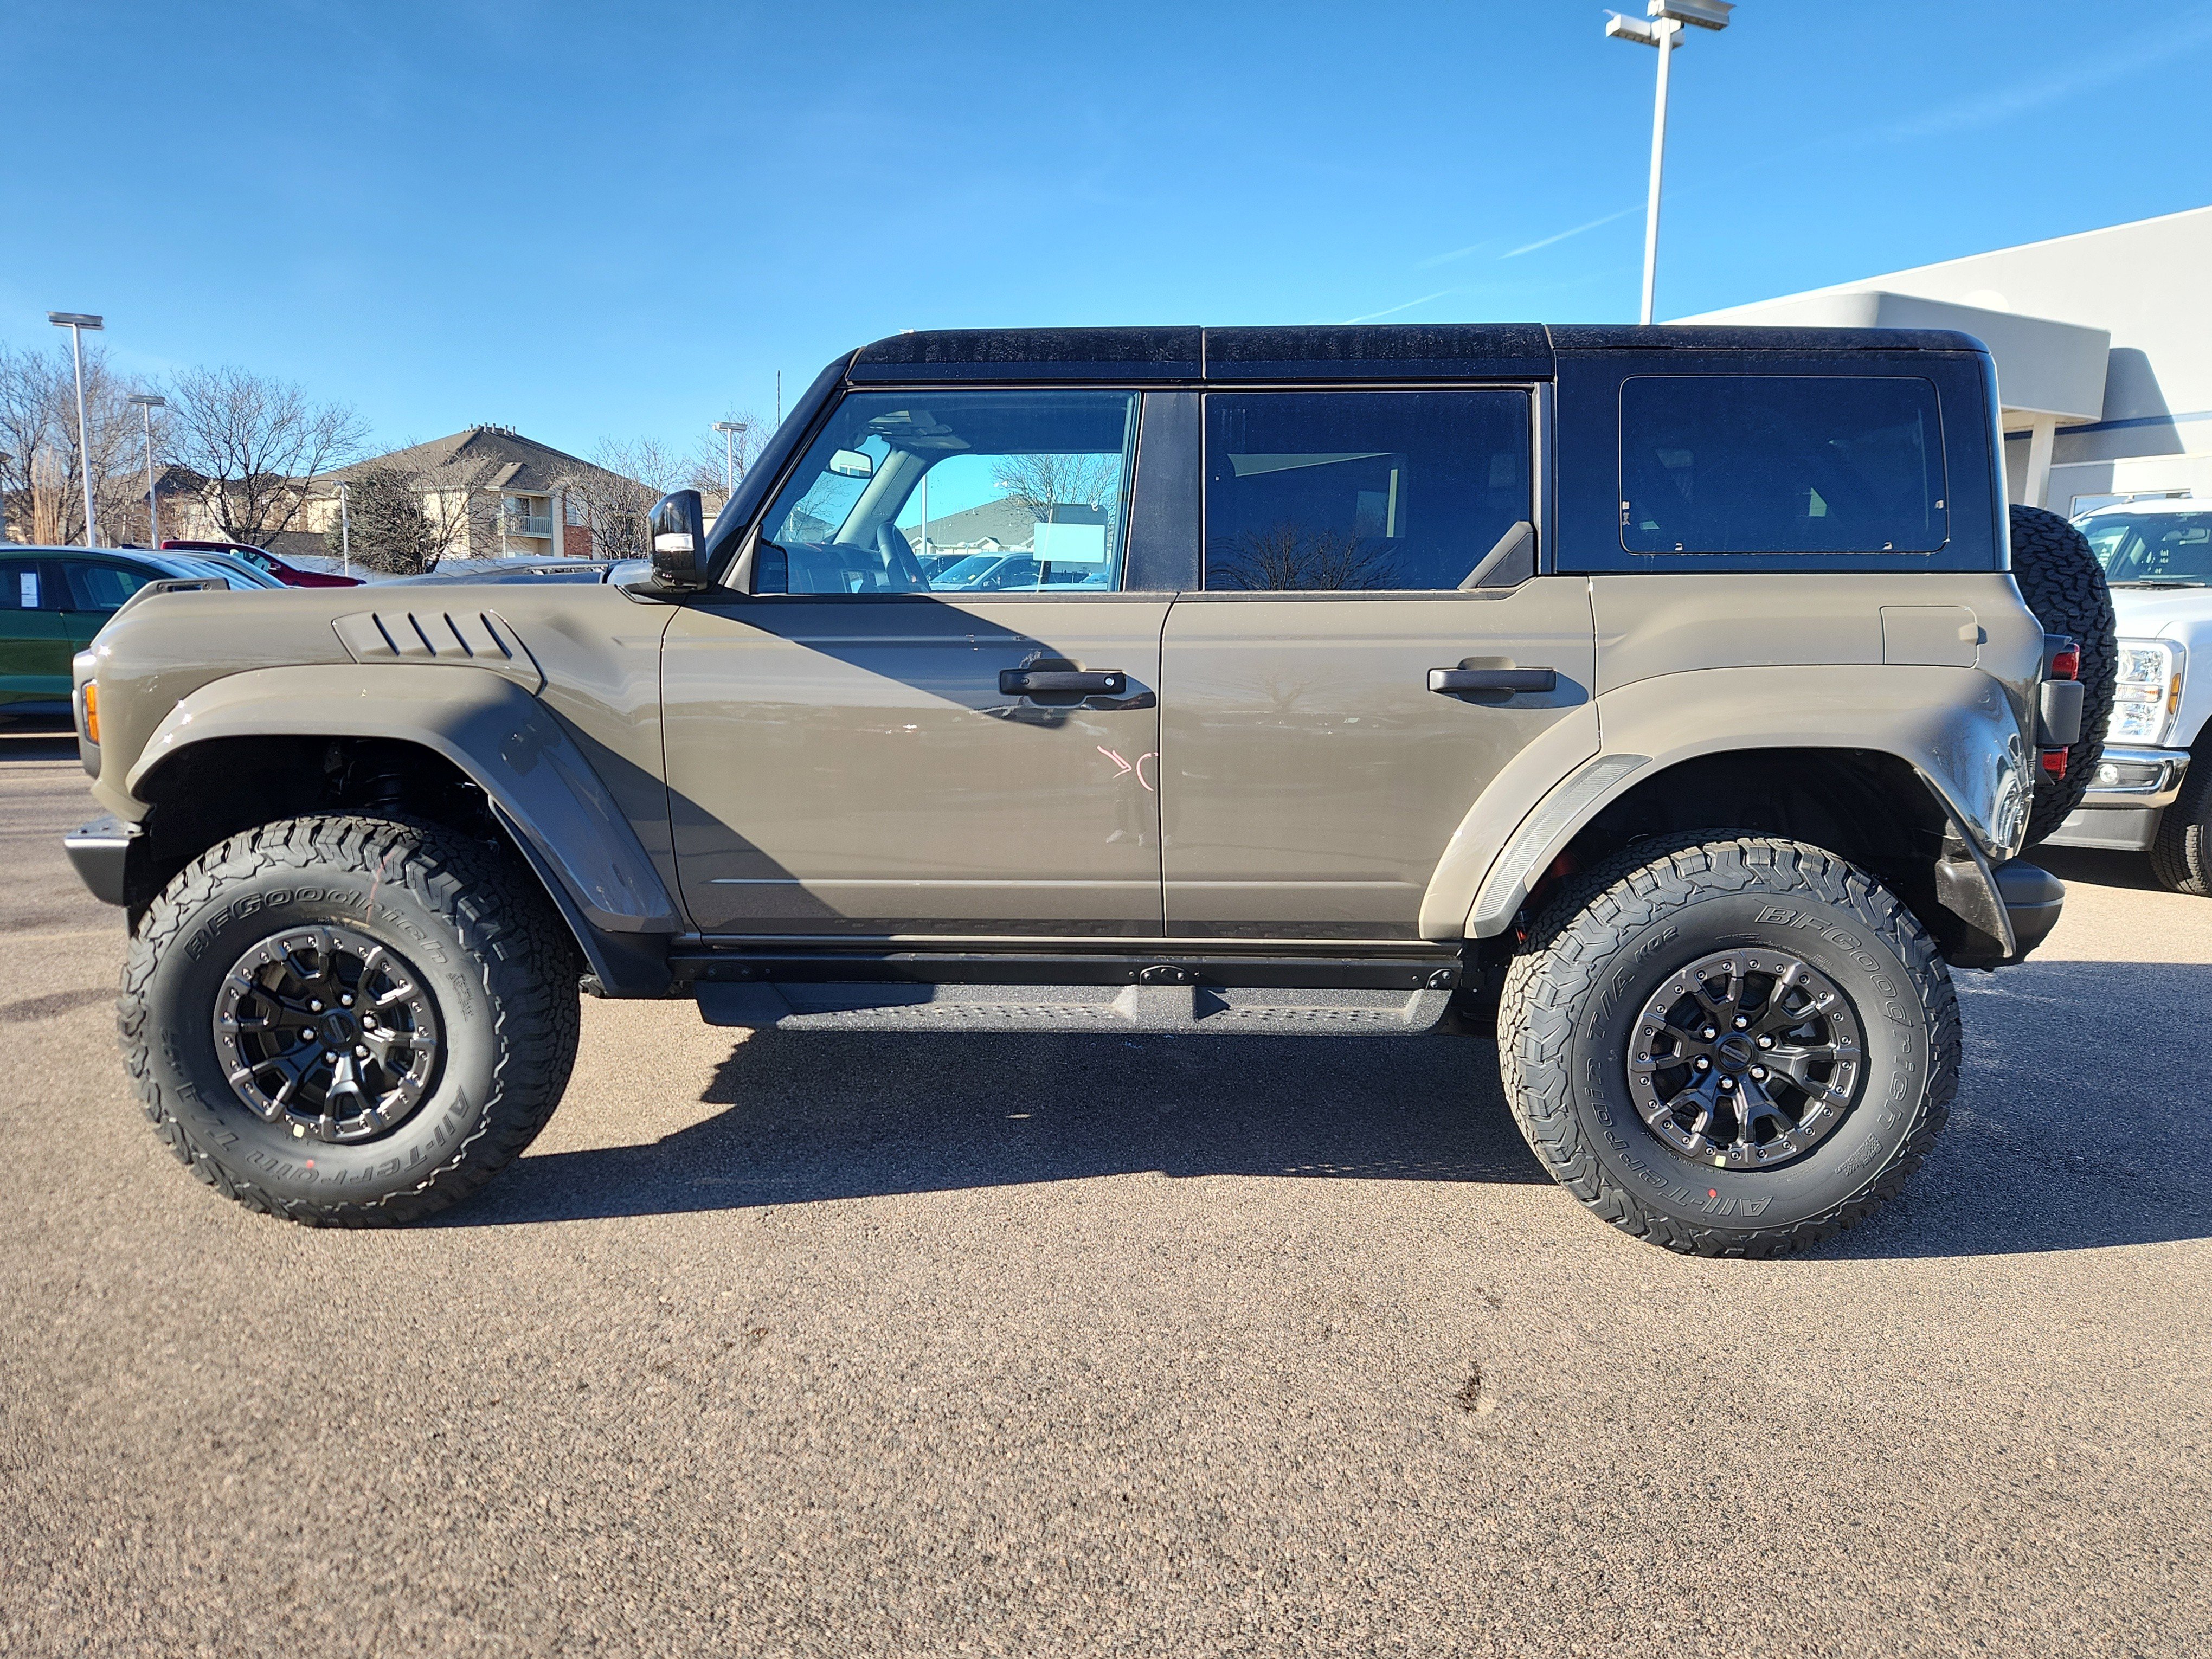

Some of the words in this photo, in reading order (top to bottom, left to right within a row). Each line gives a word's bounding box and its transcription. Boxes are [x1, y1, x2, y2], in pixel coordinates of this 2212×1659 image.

[183, 886, 449, 964] BFGoodrich
[1632, 925, 1681, 963] KO2
[1587, 955, 1637, 1039] T/A
[1754, 905, 1916, 1131] BFGoodrich
[246, 1083, 470, 1185] All-Terrain
[1582, 1058, 1774, 1218] All-Terrain
